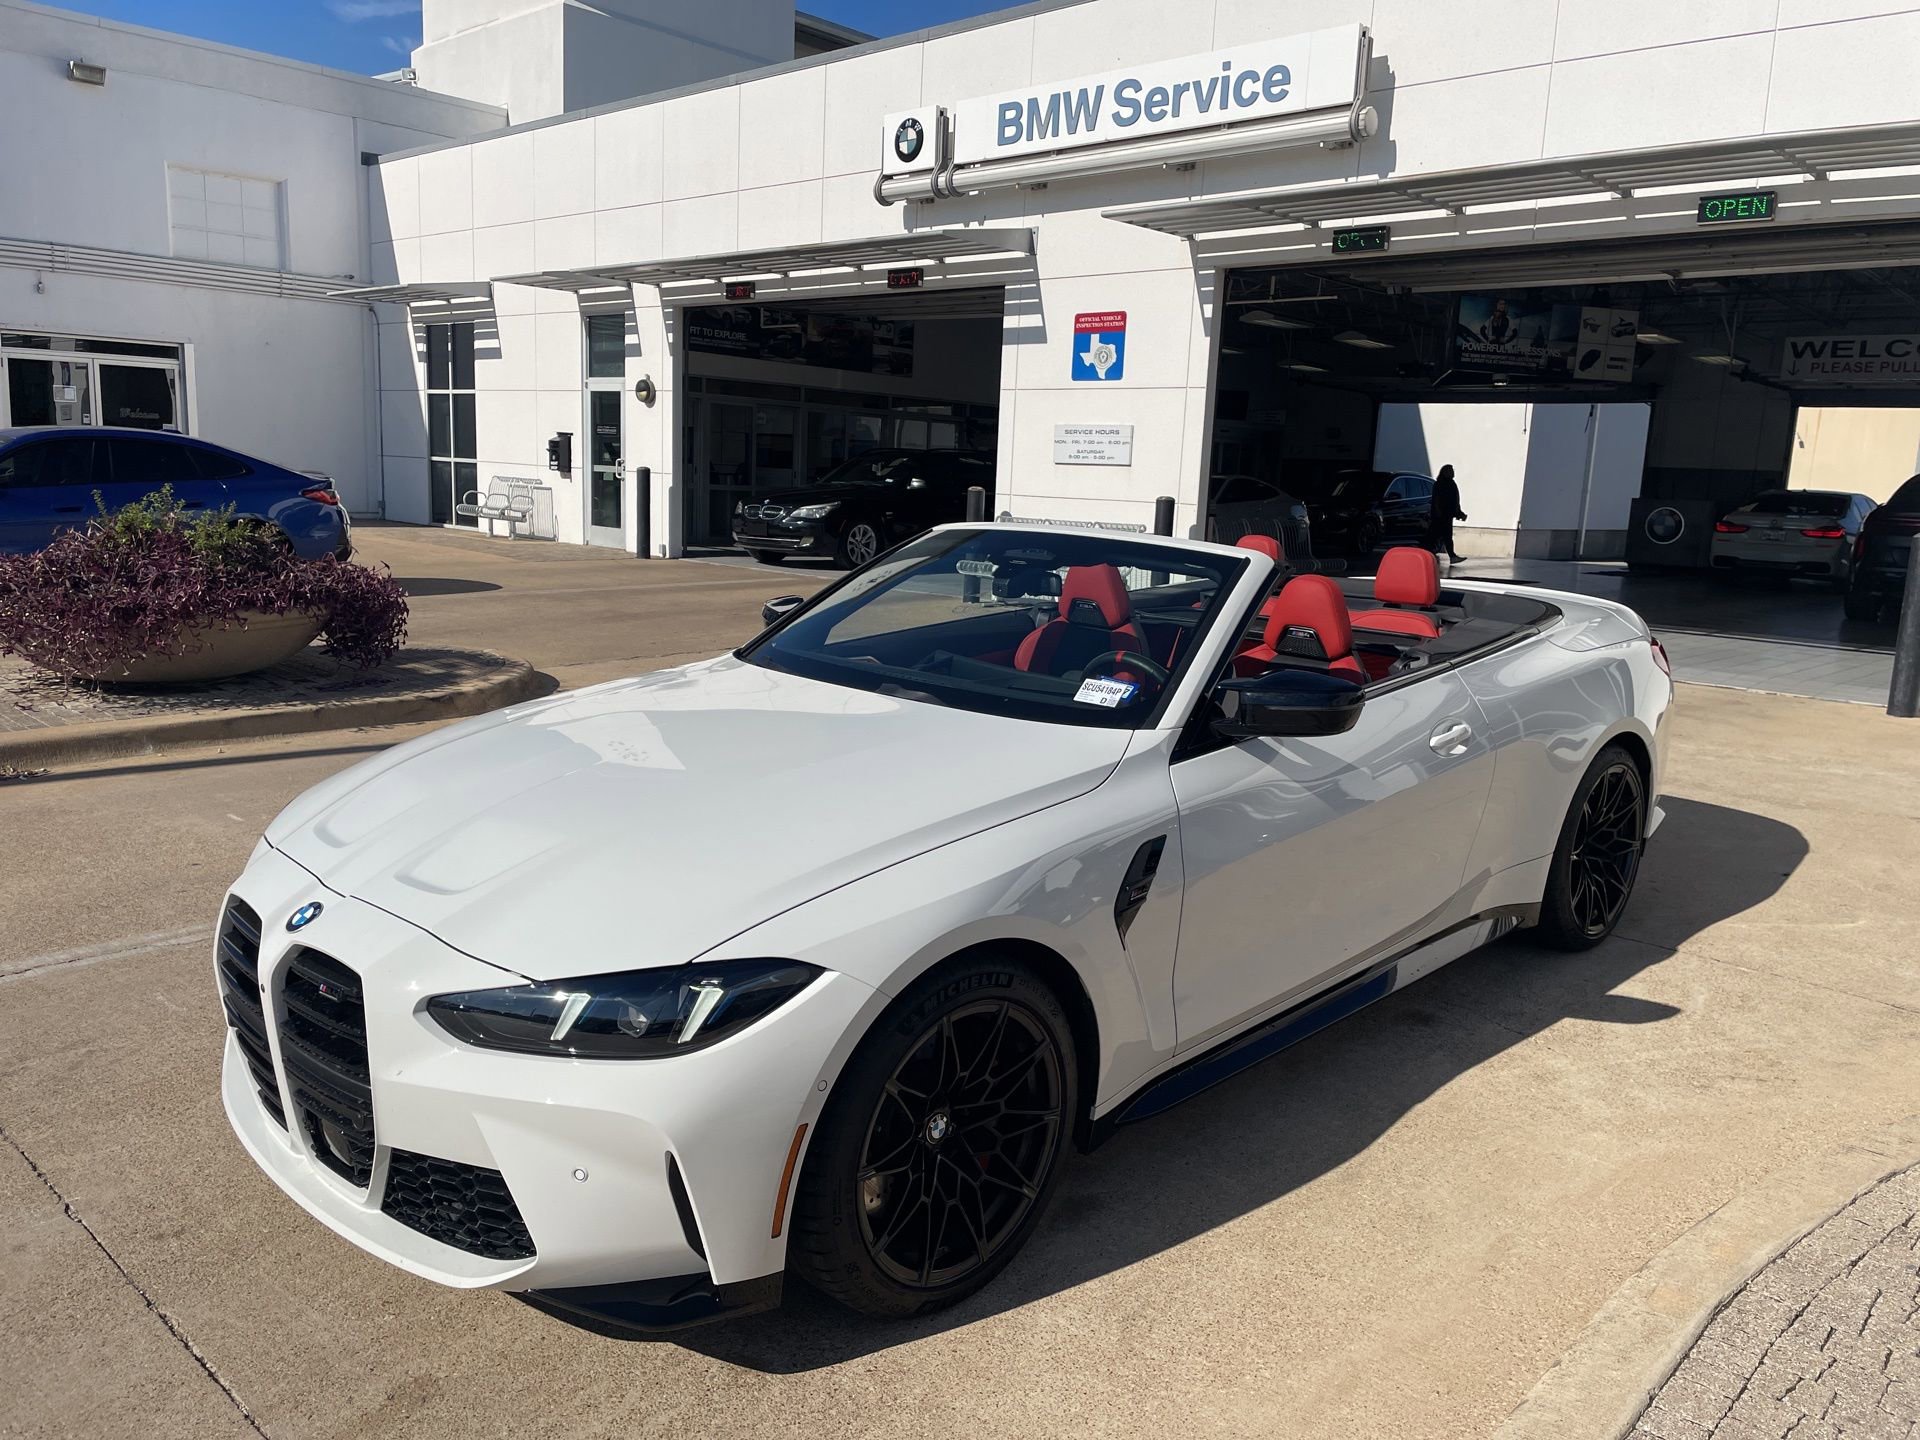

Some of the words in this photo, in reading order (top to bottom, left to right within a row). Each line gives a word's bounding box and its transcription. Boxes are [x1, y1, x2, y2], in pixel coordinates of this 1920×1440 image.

[997, 84, 1104, 147] BMW
[1111, 61, 1292, 128] Service
[1705, 196, 1767, 218] OPEN
[702, 327, 713, 336] TO
[1462, 341, 1505, 354] POWERFUL
[1790, 339, 1920, 360] WELC
[1810, 361, 1875, 374] PLEASE
[923, 973, 1010, 1013] MICHELIN
